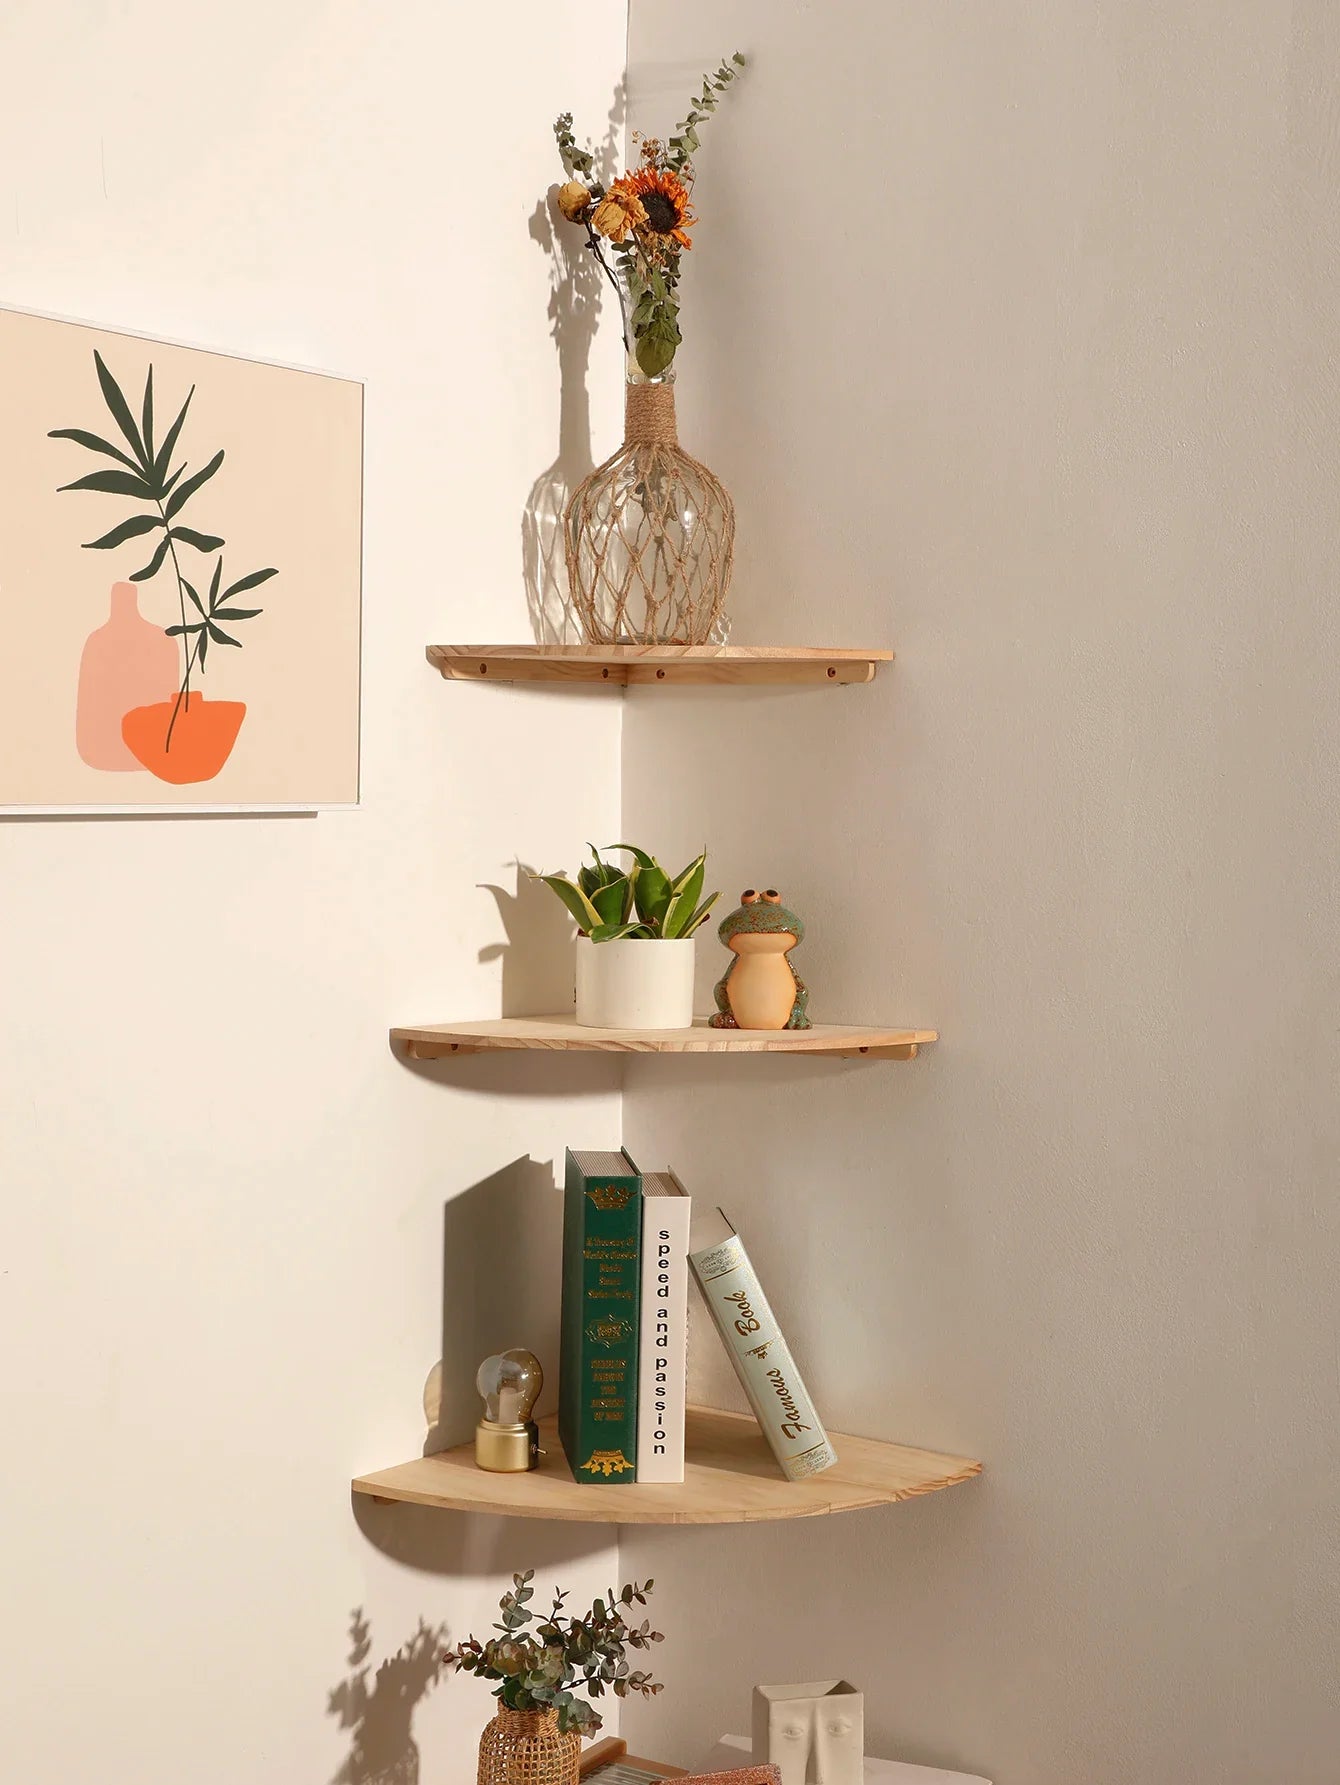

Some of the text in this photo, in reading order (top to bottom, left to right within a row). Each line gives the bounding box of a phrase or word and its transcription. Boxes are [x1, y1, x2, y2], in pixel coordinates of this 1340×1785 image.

[653, 1229, 671, 1454] speed and passion
[723, 1290, 761, 1337] Book
[766, 1367, 812, 1440] Famous
